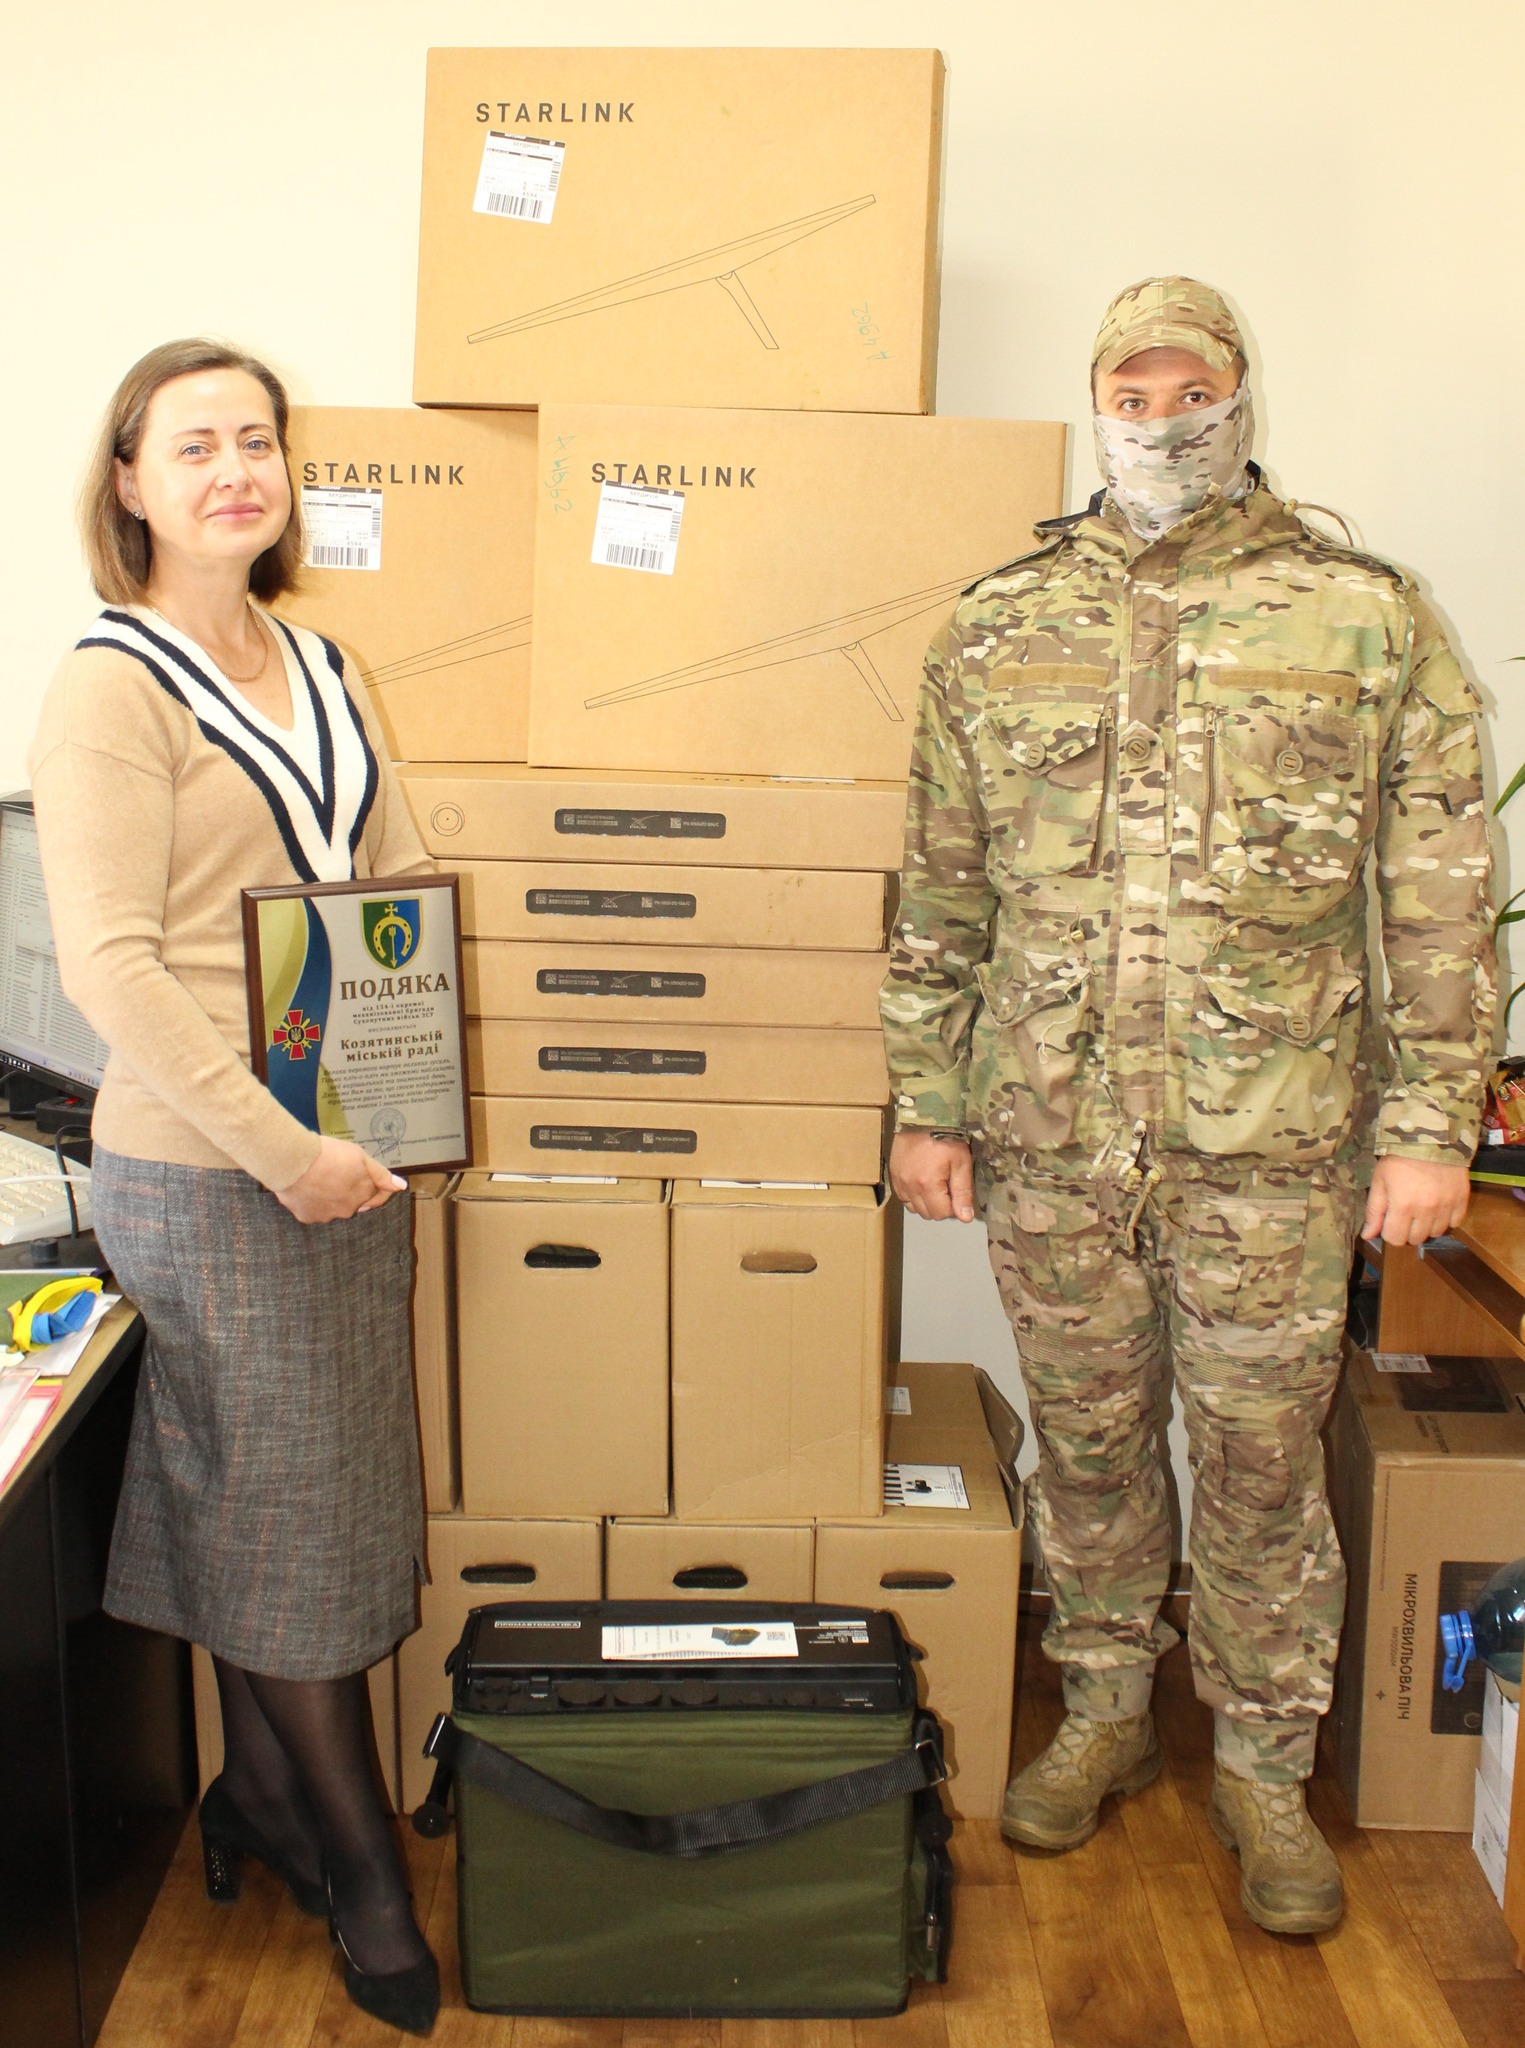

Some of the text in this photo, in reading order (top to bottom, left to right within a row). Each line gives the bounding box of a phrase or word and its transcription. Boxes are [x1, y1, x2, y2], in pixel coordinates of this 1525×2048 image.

[475, 102, 635, 123] STARLINK
[303, 462, 464, 485] STARLINK
[591, 462, 757, 488] STARLINK
[340, 973, 450, 1001] ПОДЯКА
[341, 1029, 443, 1050] Козятинській
[346, 1043, 439, 1062] міській раді
[1397, 1573, 1418, 1720] МІКРОХВИЛЬОВА ПІЧ
